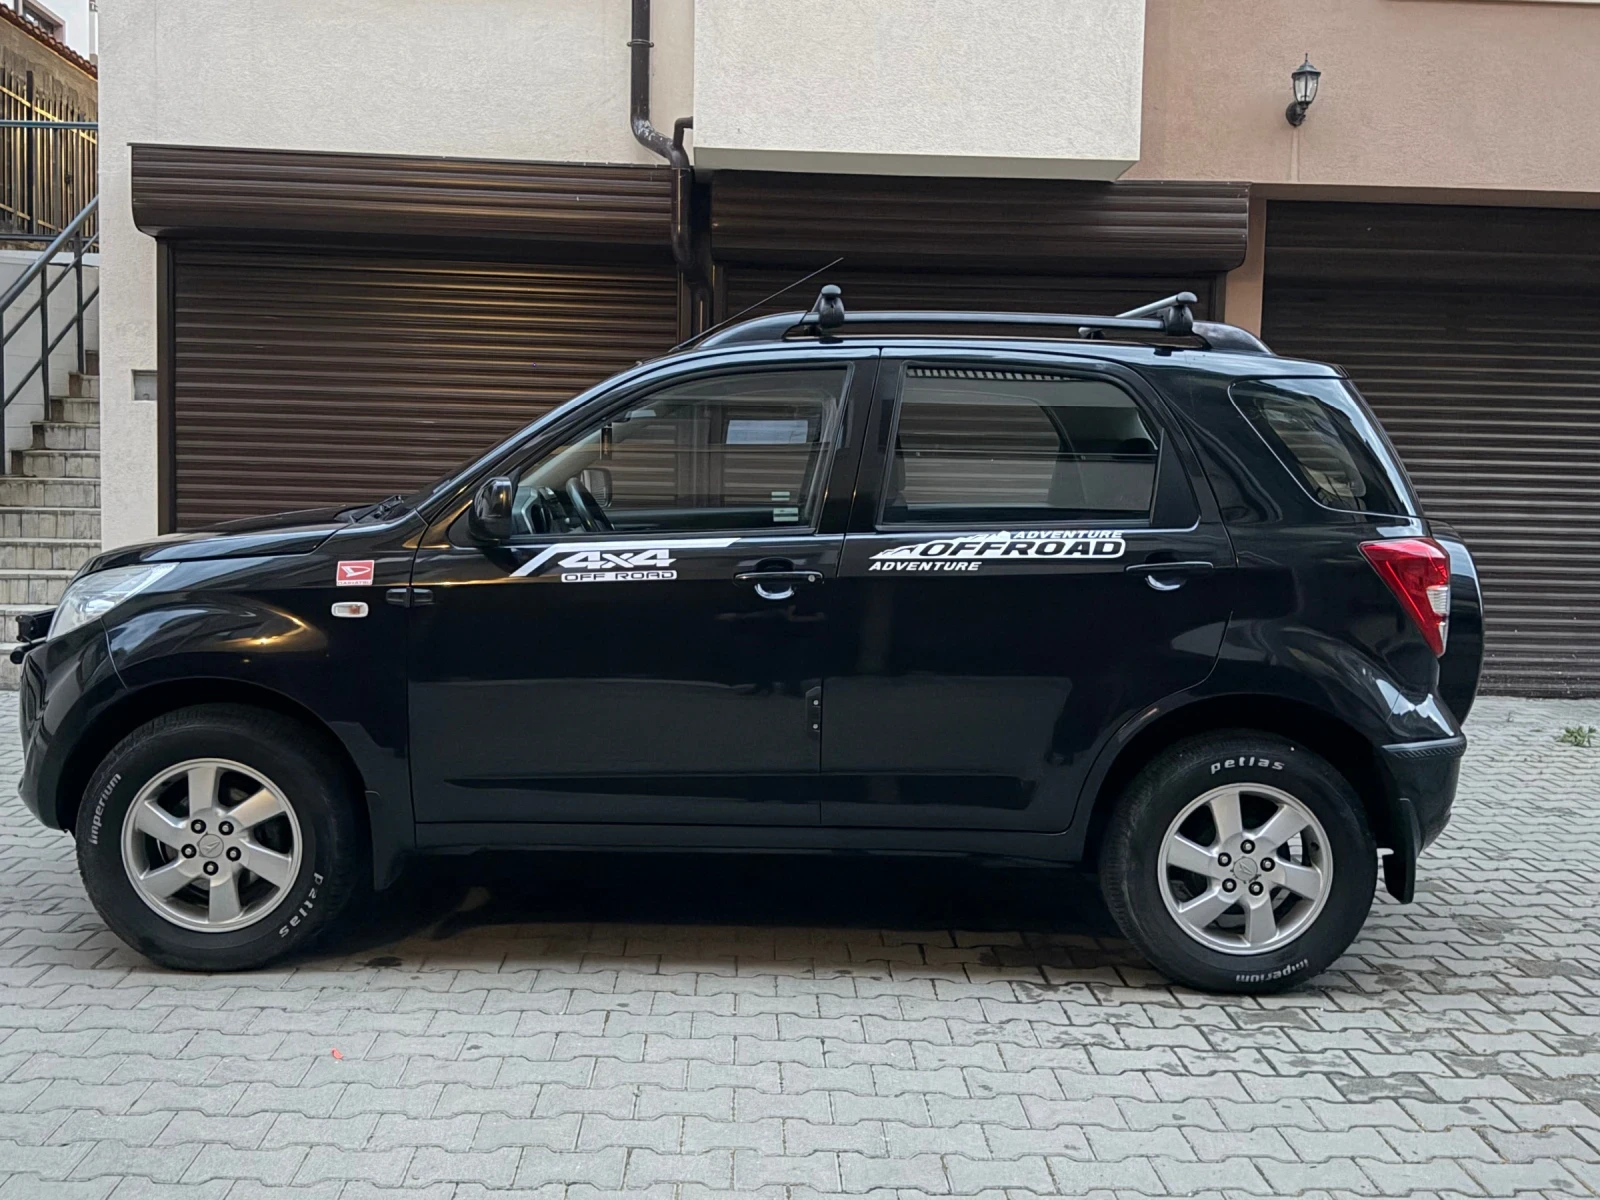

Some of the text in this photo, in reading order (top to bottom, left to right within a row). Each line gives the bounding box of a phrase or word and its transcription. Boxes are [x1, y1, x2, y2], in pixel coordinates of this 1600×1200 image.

[1014, 530, 1124, 540] ADVENTURE
[918, 541, 1122, 557] OFFROAD
[868, 561, 982, 571] ADVENTURE
[565, 571, 674, 581] OFF ROAD
